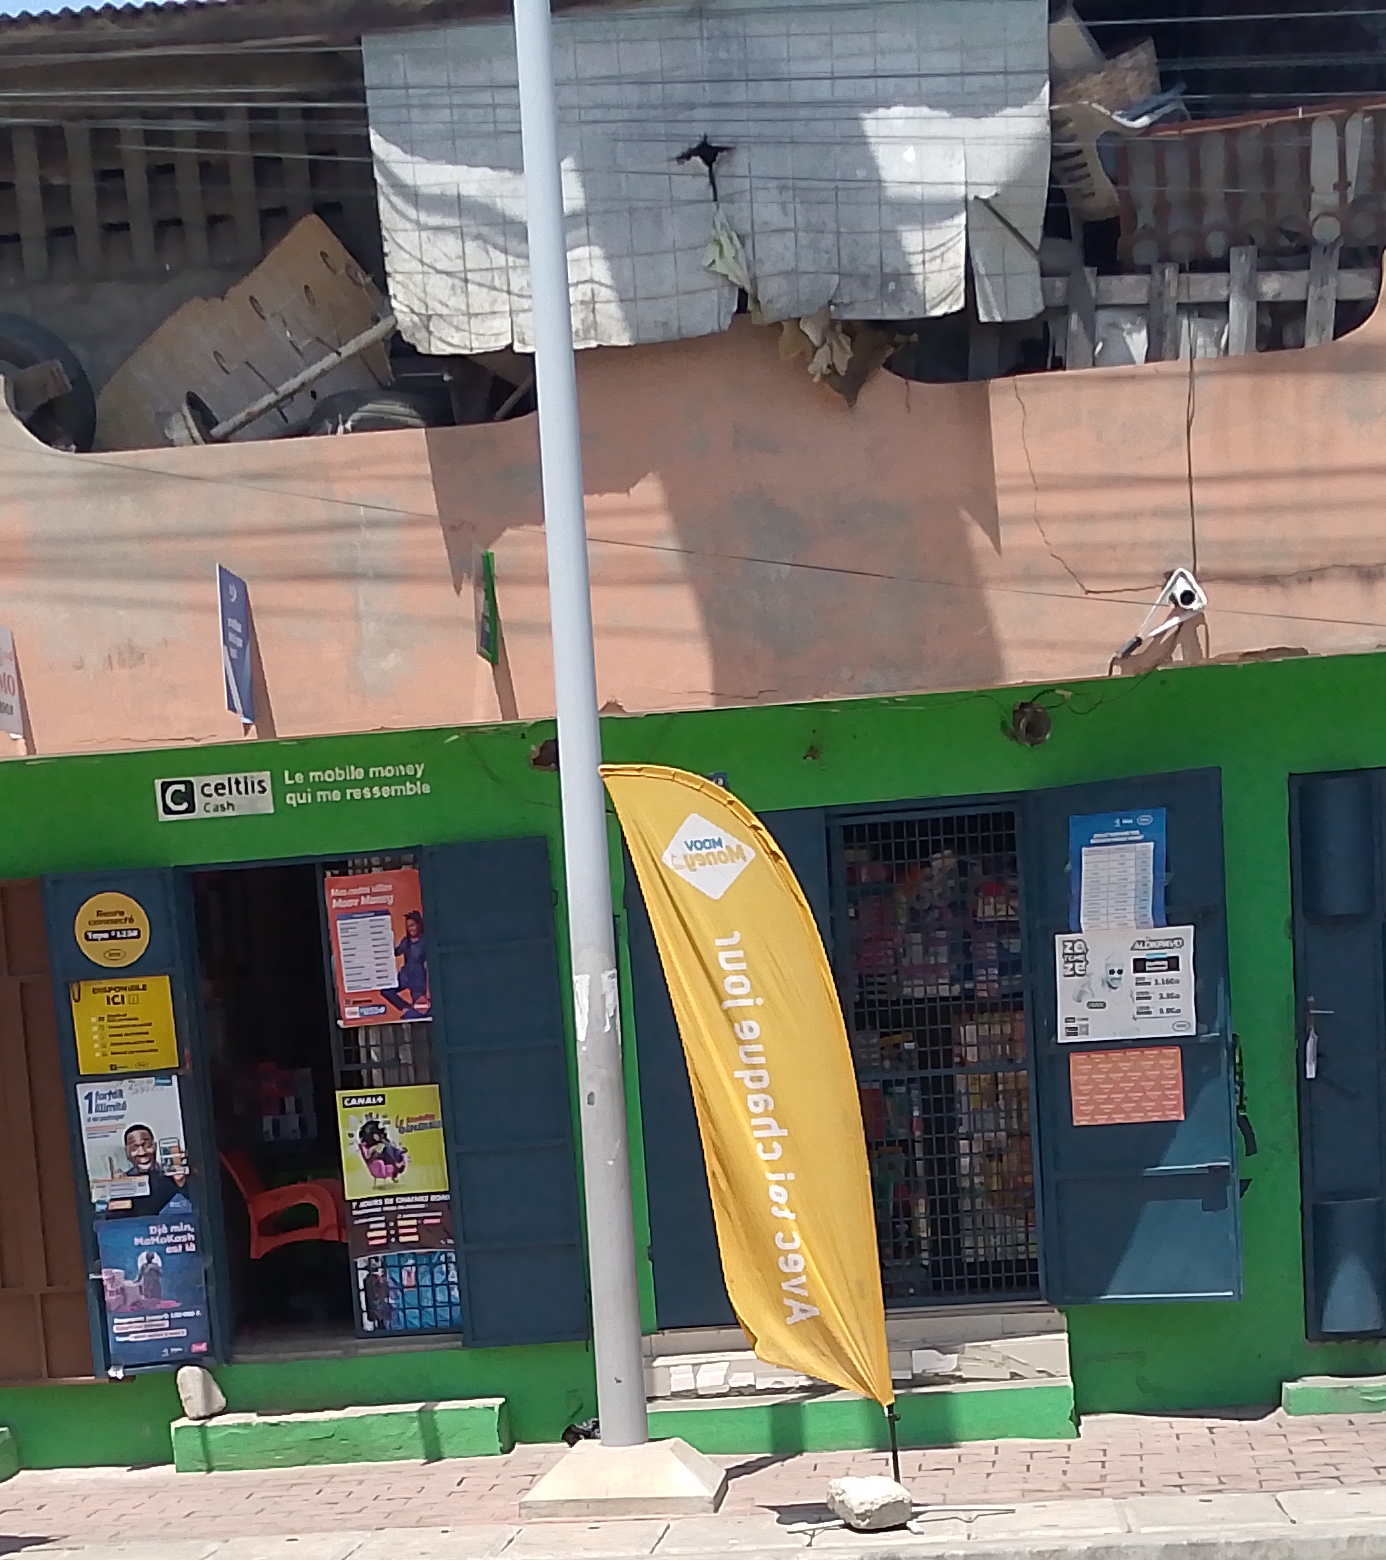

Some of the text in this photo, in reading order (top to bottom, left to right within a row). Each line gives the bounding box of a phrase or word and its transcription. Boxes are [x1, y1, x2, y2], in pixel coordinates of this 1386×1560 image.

[284, 762, 425, 785] Le mobile money
[200, 776, 268, 798] celtiis
[285, 781, 431, 807] qui me ressemble
[203, 801, 236, 813] Cash
[106, 994, 126, 1006] ICI
[343, 1095, 384, 1107] CANAL+
